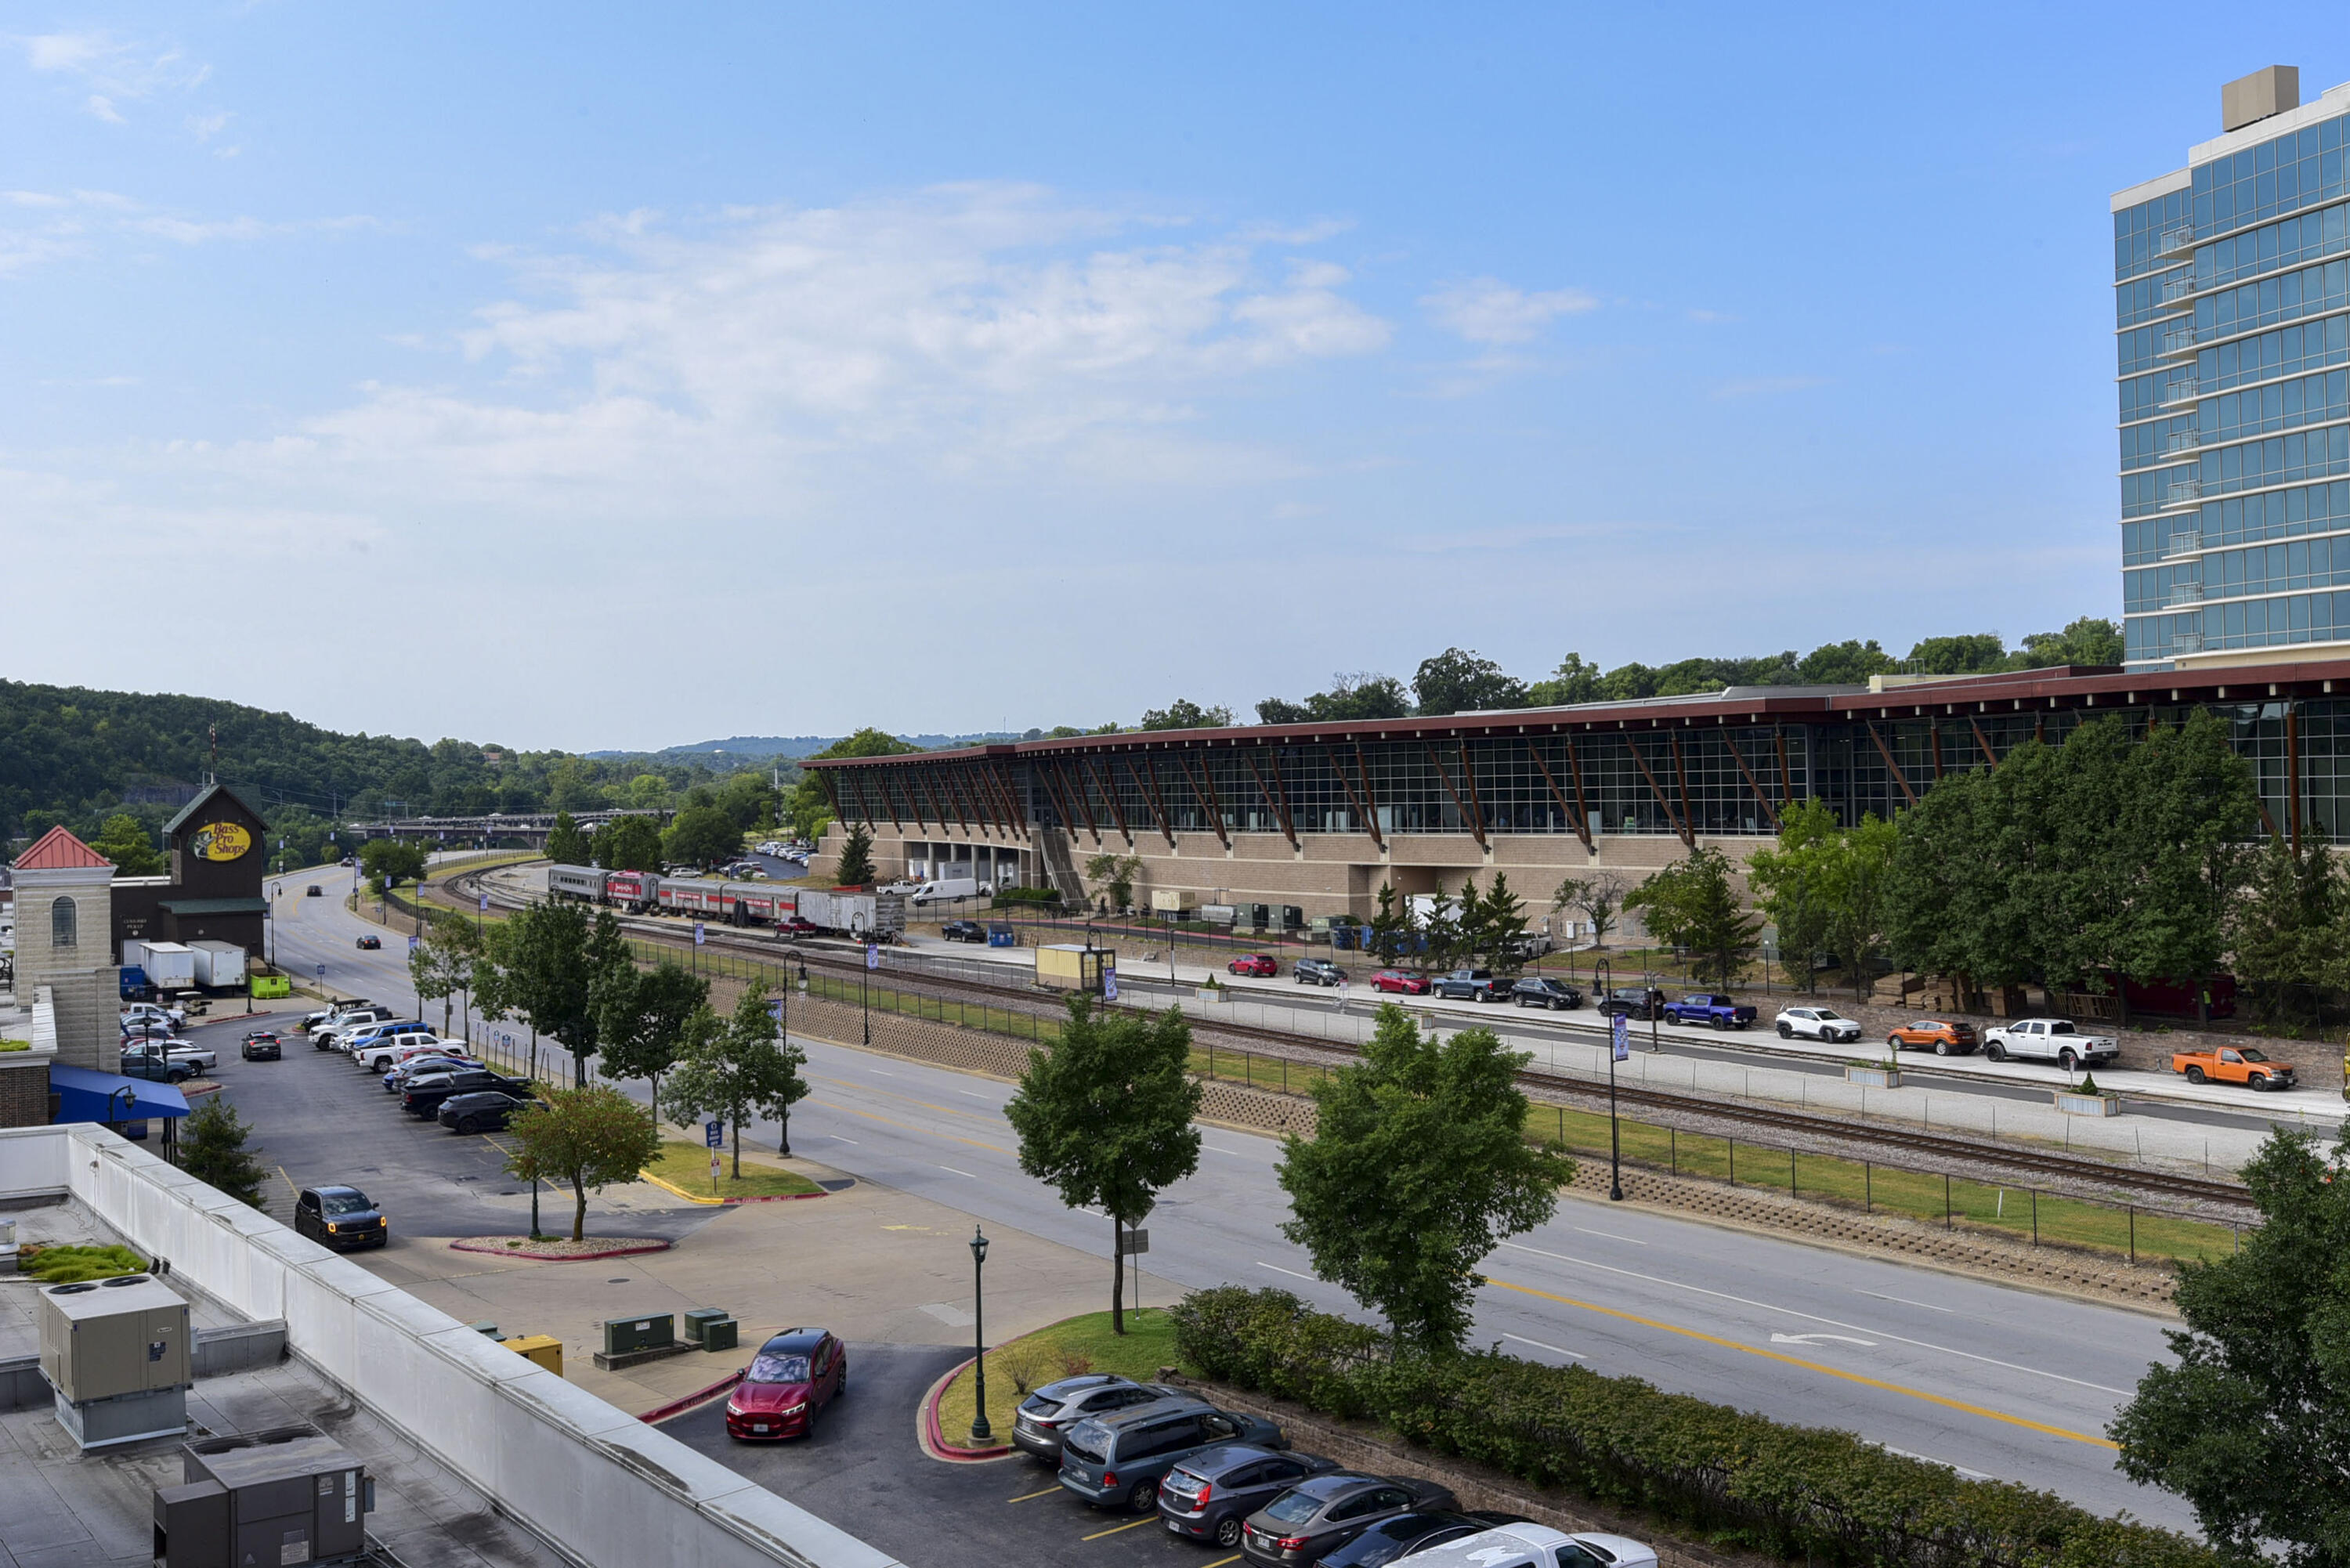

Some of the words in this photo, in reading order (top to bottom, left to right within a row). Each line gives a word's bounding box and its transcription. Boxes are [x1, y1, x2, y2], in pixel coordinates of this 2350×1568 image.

[214, 823, 239, 834] Bass
[215, 833, 233, 844] Pro
[215, 843, 246, 855] Shops
